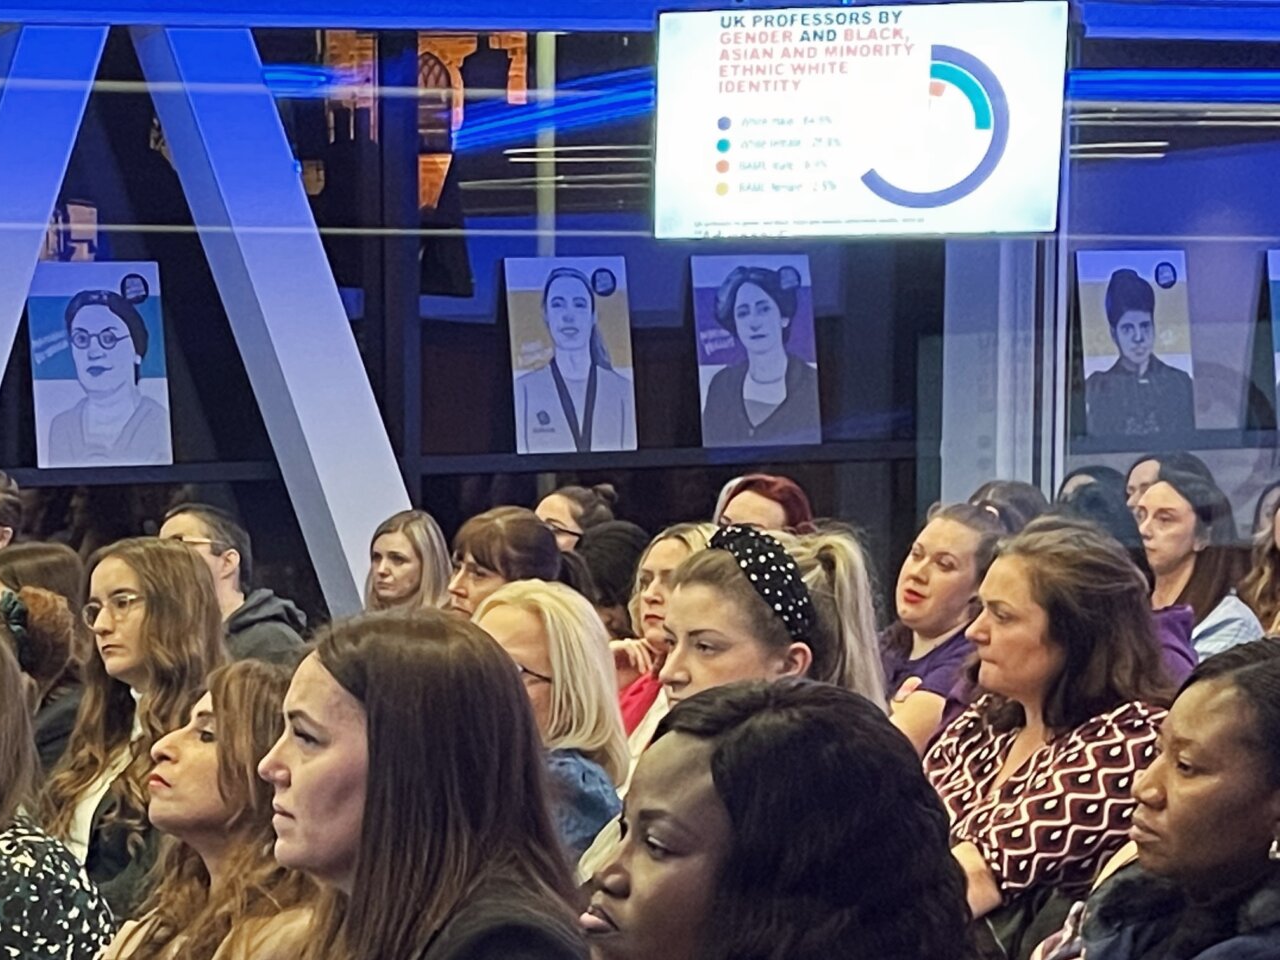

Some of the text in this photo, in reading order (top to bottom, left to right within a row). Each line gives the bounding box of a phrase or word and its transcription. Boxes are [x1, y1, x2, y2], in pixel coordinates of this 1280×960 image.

[720, 11, 902, 28] UK PROFESSORS BY
[720, 27, 910, 44] GENDER AND BLACK,
[719, 44, 915, 61] ASIAN AND MINORITY
[719, 61, 848, 77] ETHNIC WHITE
[718, 80, 801, 94] IDENTITY
